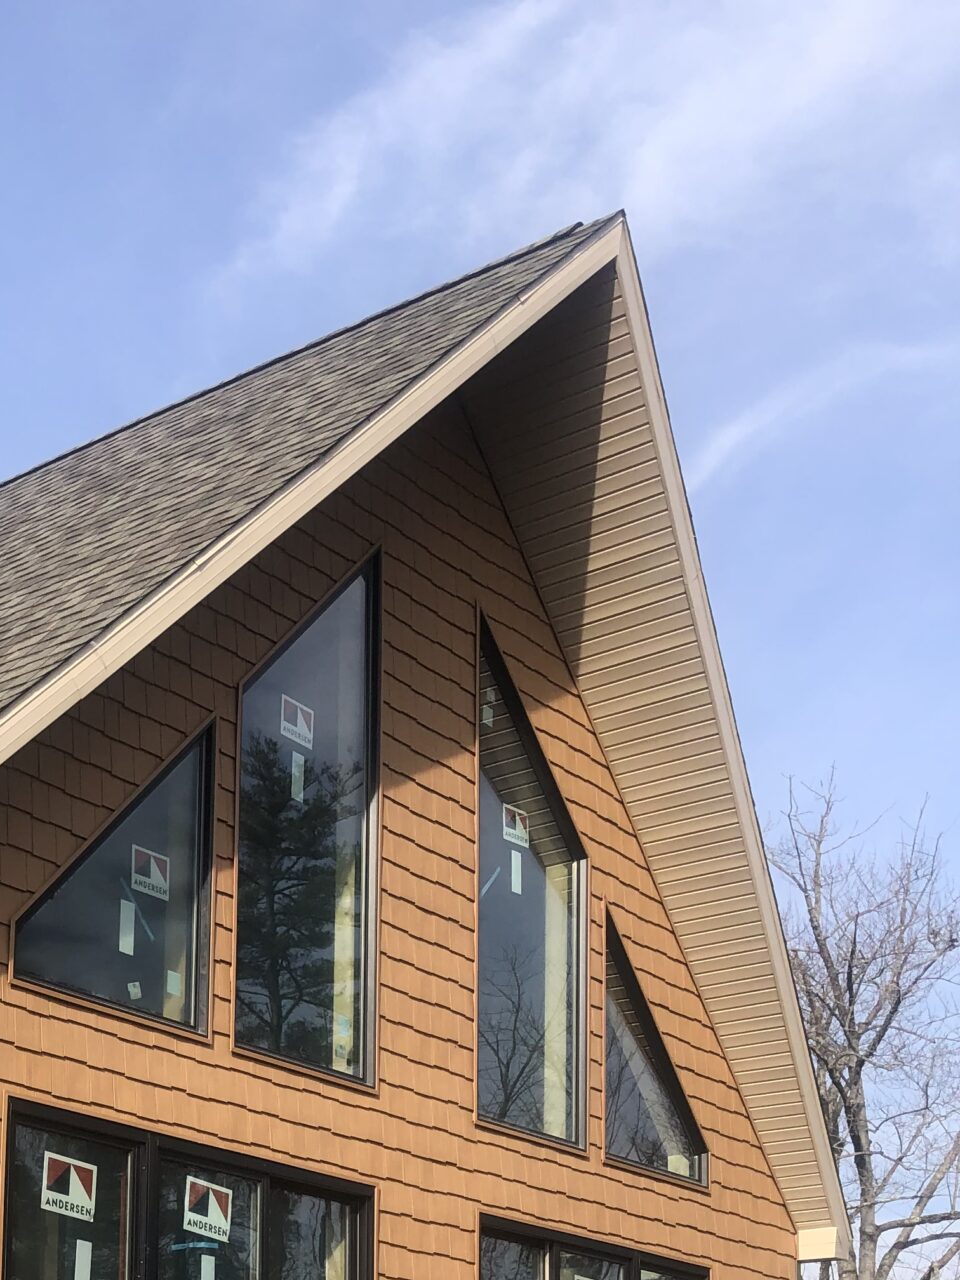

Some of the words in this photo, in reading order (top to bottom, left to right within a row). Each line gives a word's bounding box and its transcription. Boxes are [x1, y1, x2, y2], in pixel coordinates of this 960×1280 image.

[133, 878, 168, 896] ANDERSEN
[45, 1196, 92, 1217] ANDERSEN
[186, 1218, 228, 1237] ANDERSEN
